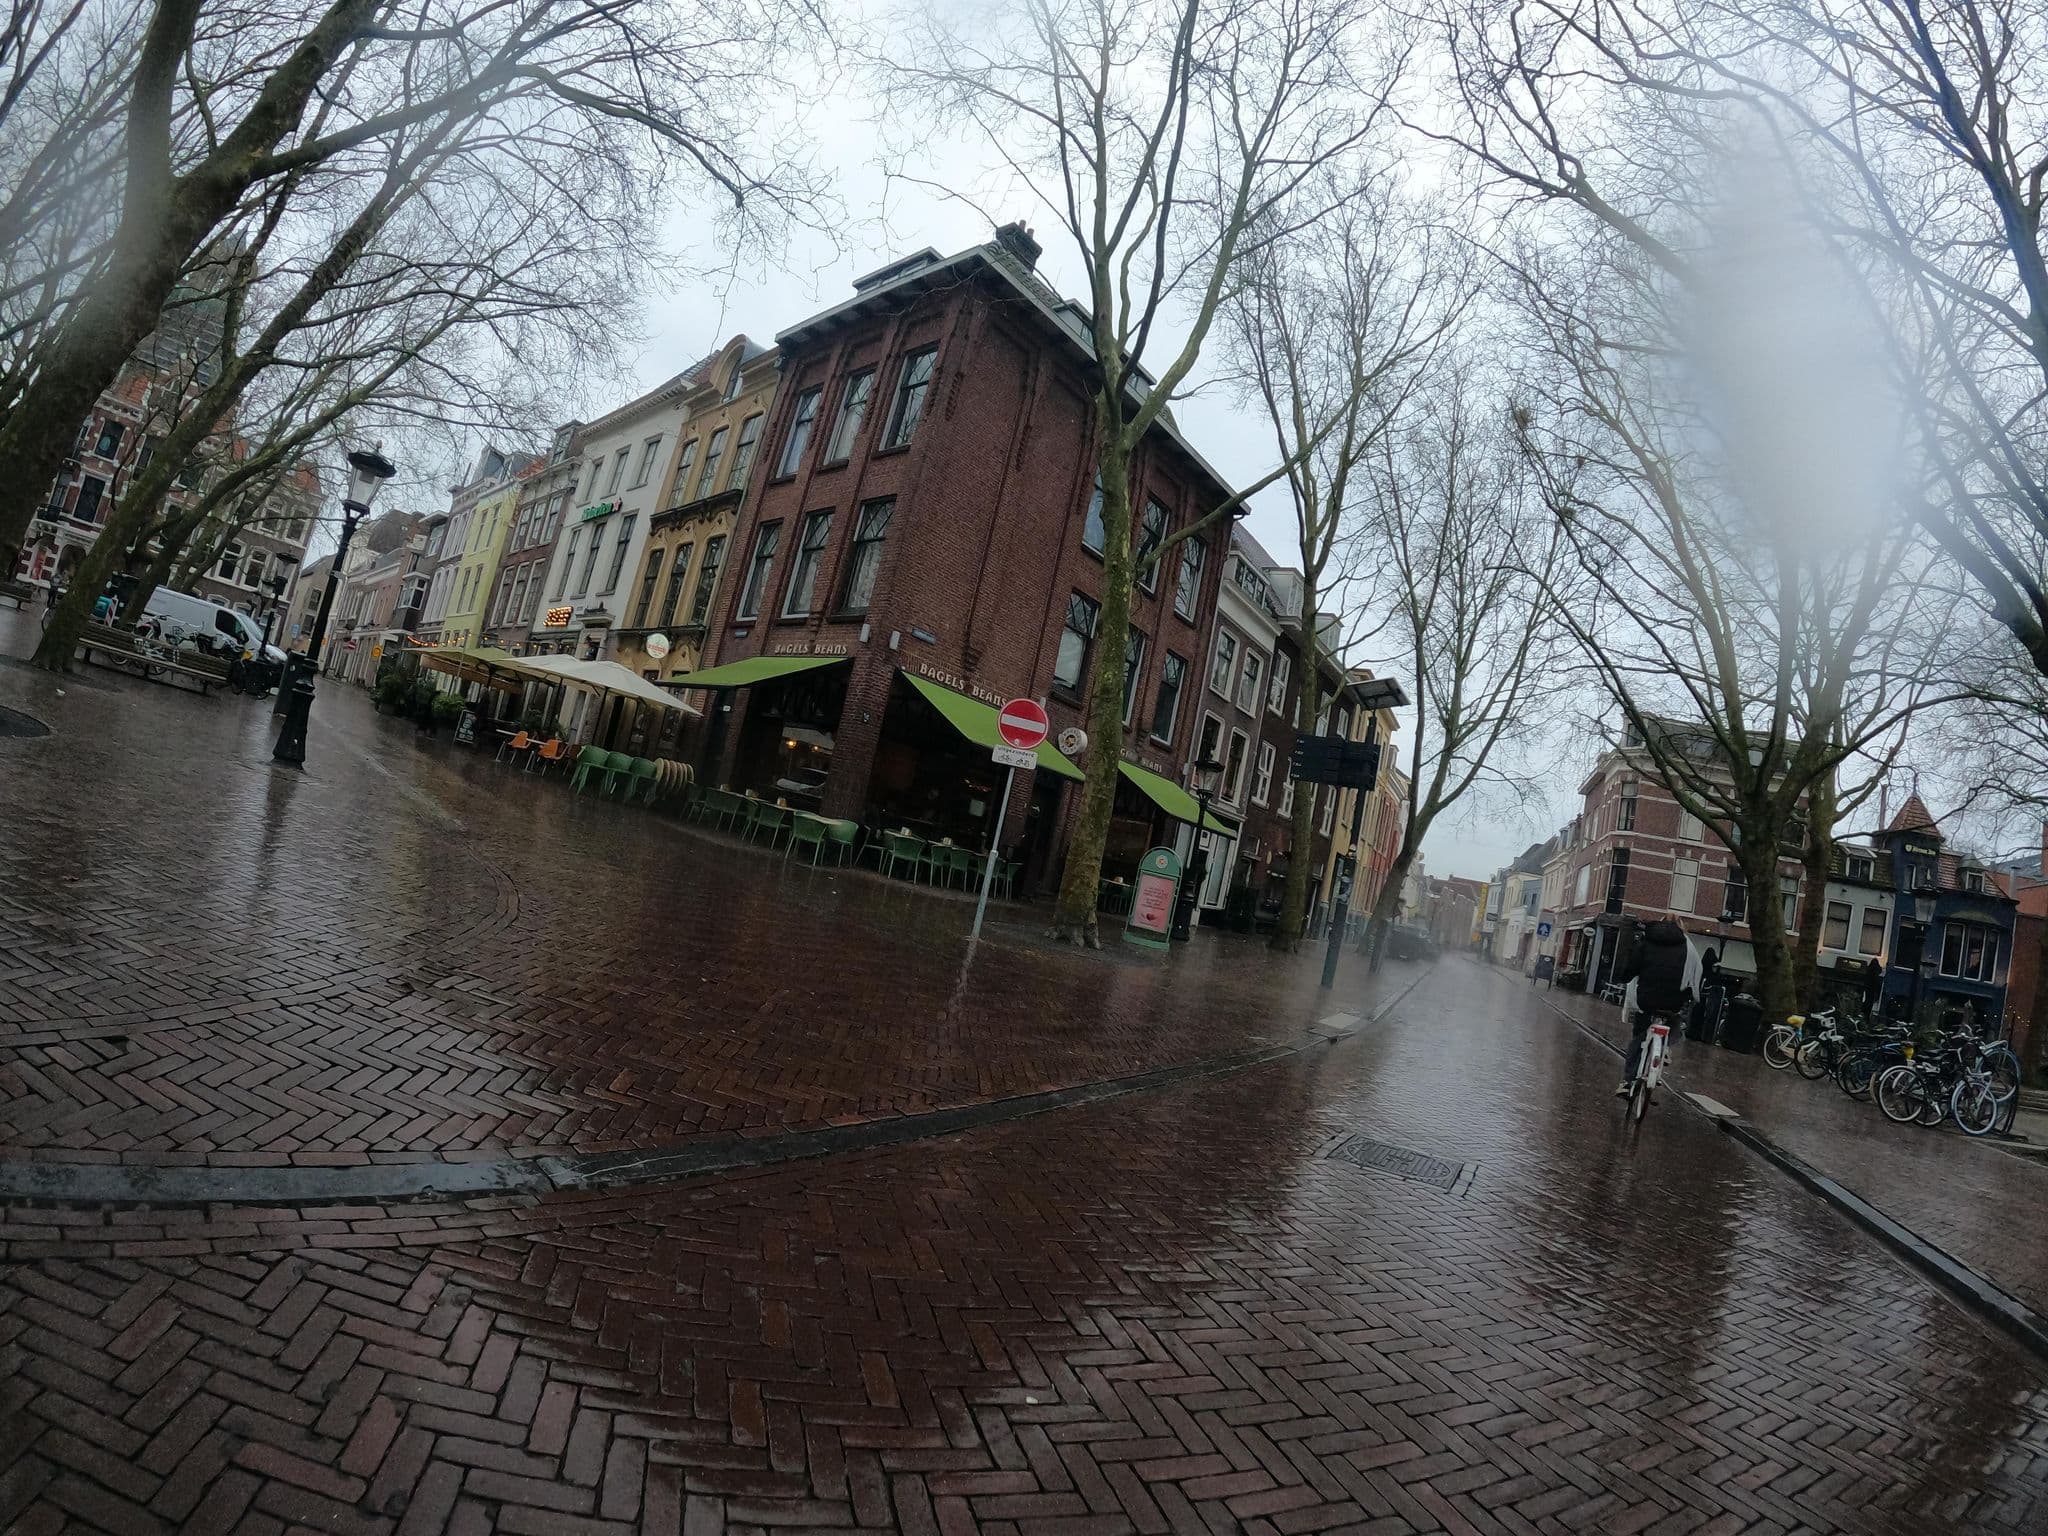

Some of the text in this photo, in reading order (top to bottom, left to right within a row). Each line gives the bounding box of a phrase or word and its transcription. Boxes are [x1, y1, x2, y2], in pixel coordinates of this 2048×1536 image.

[814, 643, 848, 656] BEANS
[919, 663, 1008, 709] BAGELS BEANS
